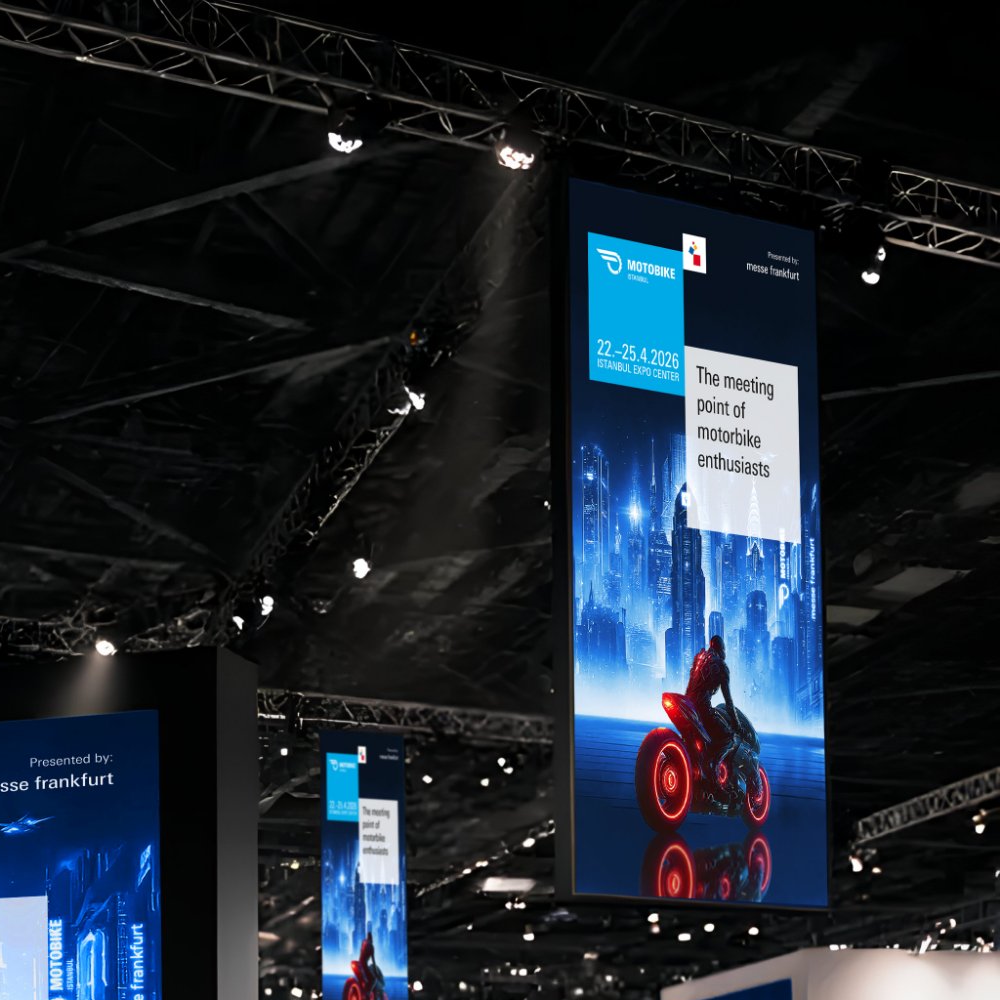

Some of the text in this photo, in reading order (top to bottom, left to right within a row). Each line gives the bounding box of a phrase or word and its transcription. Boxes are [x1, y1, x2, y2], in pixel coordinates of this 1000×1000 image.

[627, 259, 676, 280] MOTOBIKE
[746, 262, 800, 281] messe frankfurt
[597, 358, 680, 382] ISTANBUL EXPO CENTER
[696, 365, 775, 401] The meeting
[697, 396, 746, 419] point of
[697, 426, 762, 449] motorbike
[697, 452, 771, 478] enthusiasts
[30, 753, 114, 768] Presented by:
[34, 772, 115, 790] frankfurt
[49, 919, 64, 991] MOTOBIKE
[130, 923, 144, 990] frankfurt
